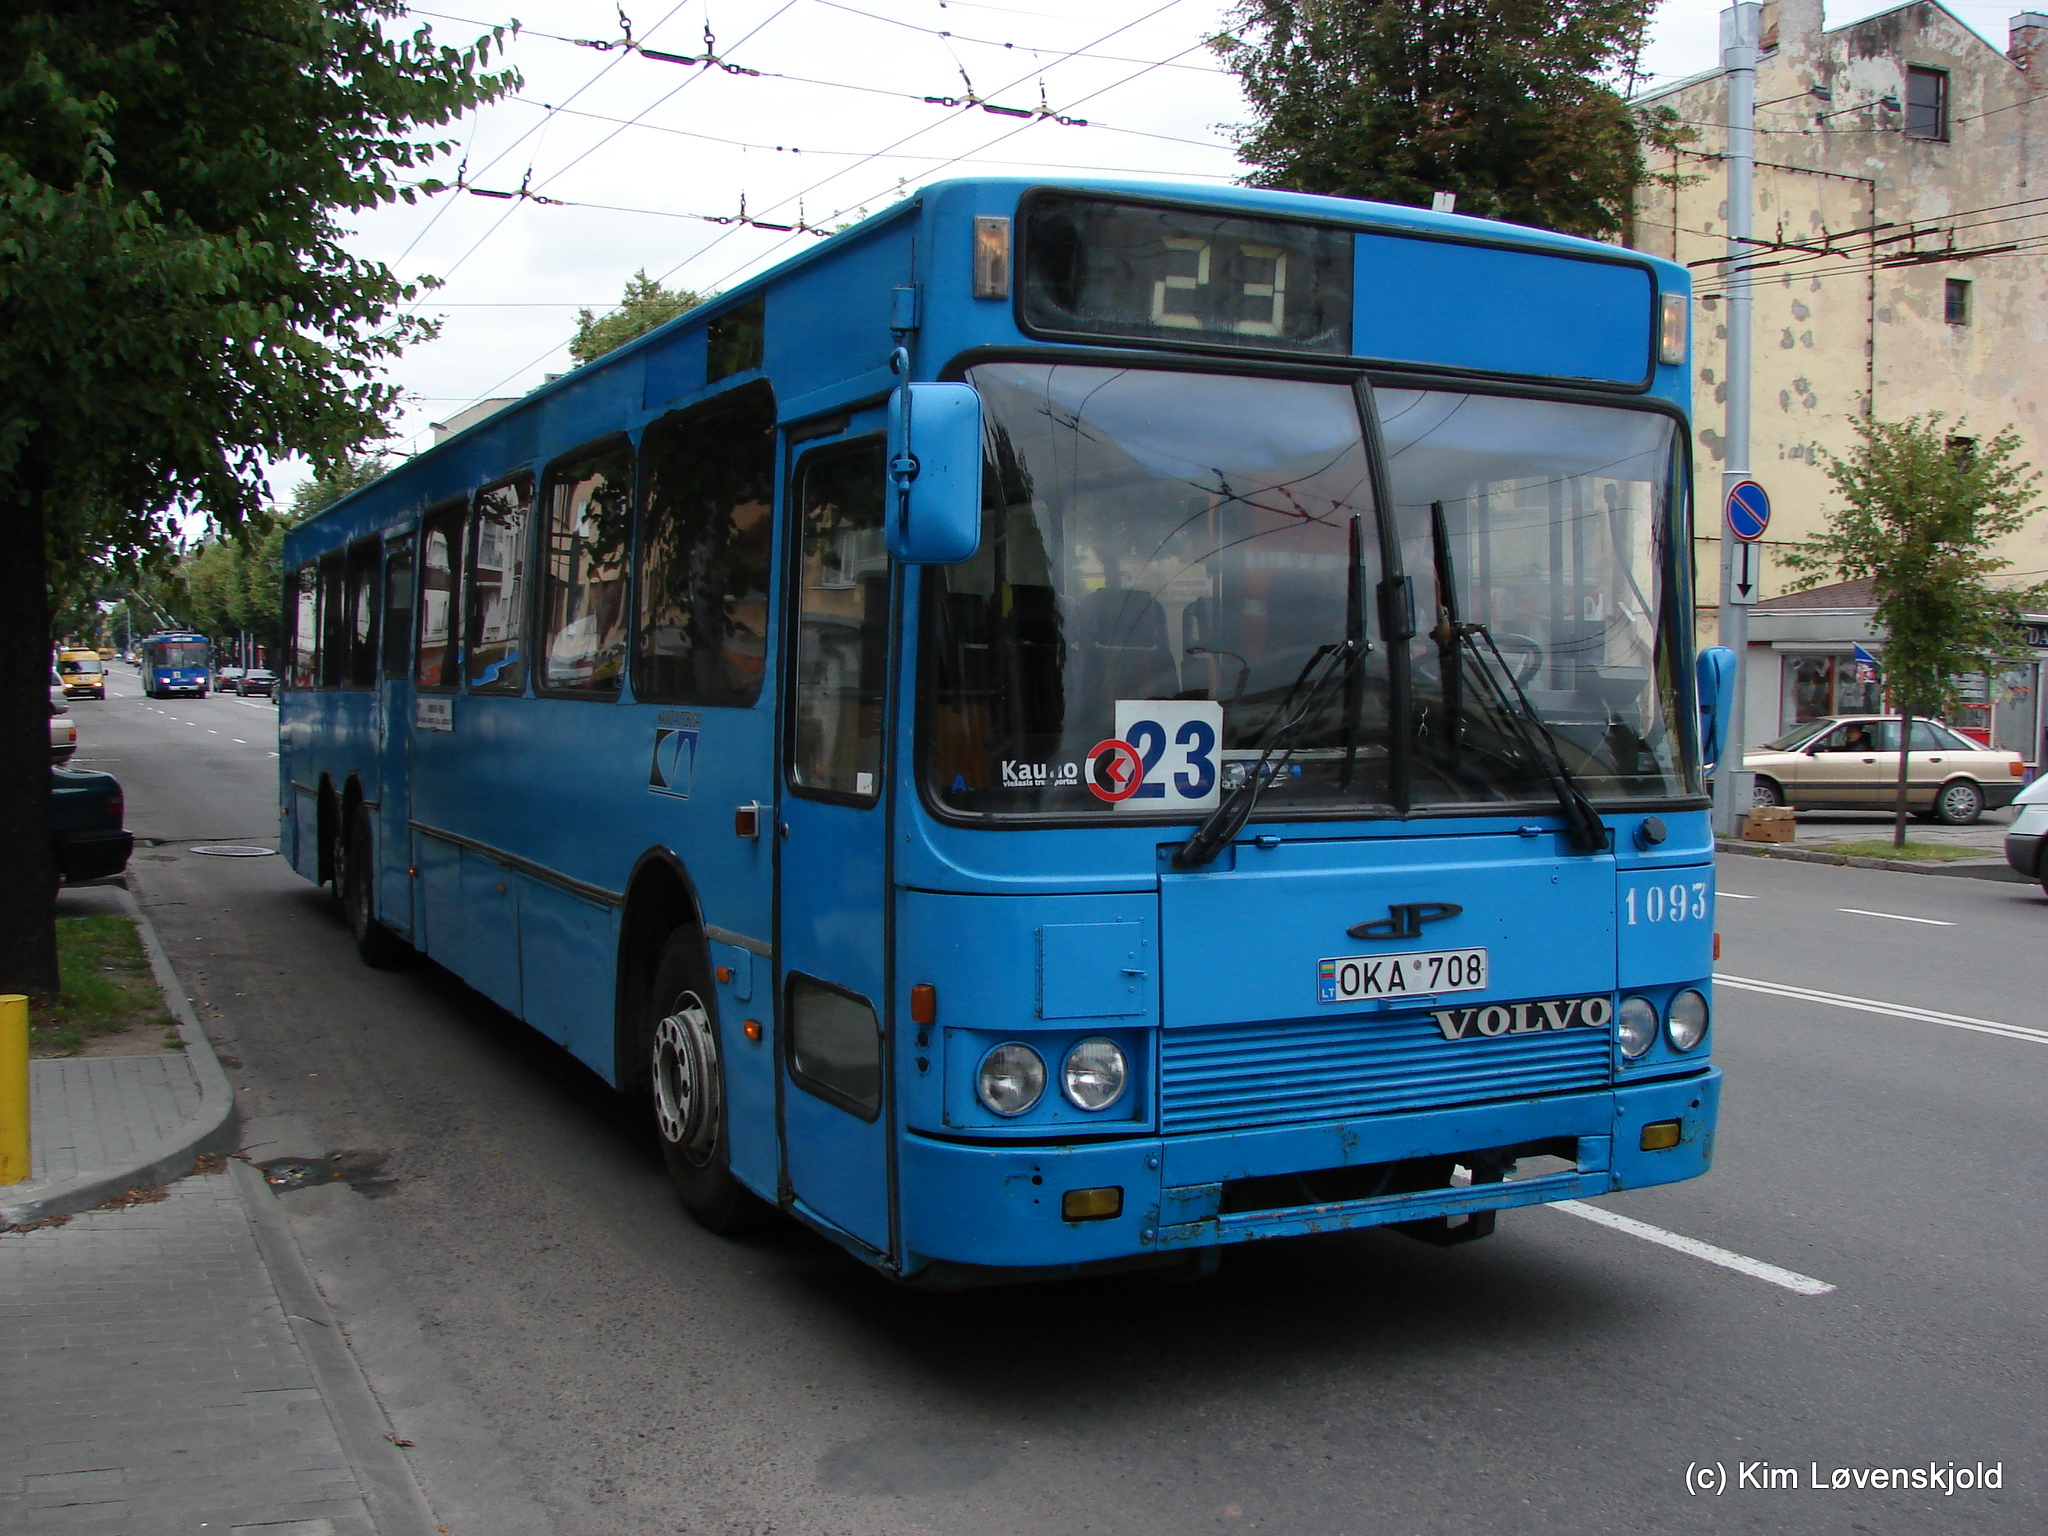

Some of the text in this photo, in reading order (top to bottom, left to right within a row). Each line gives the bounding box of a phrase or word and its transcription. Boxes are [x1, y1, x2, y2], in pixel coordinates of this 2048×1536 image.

[1152, 236, 1287, 336] 23
[1125, 720, 1216, 799] 23
[1624, 882, 1707, 926] 1093
[1321, 988, 1335, 998] LT
[1340, 953, 1482, 996] OKA 708
[1430, 997, 1612, 1041] VOLVO
